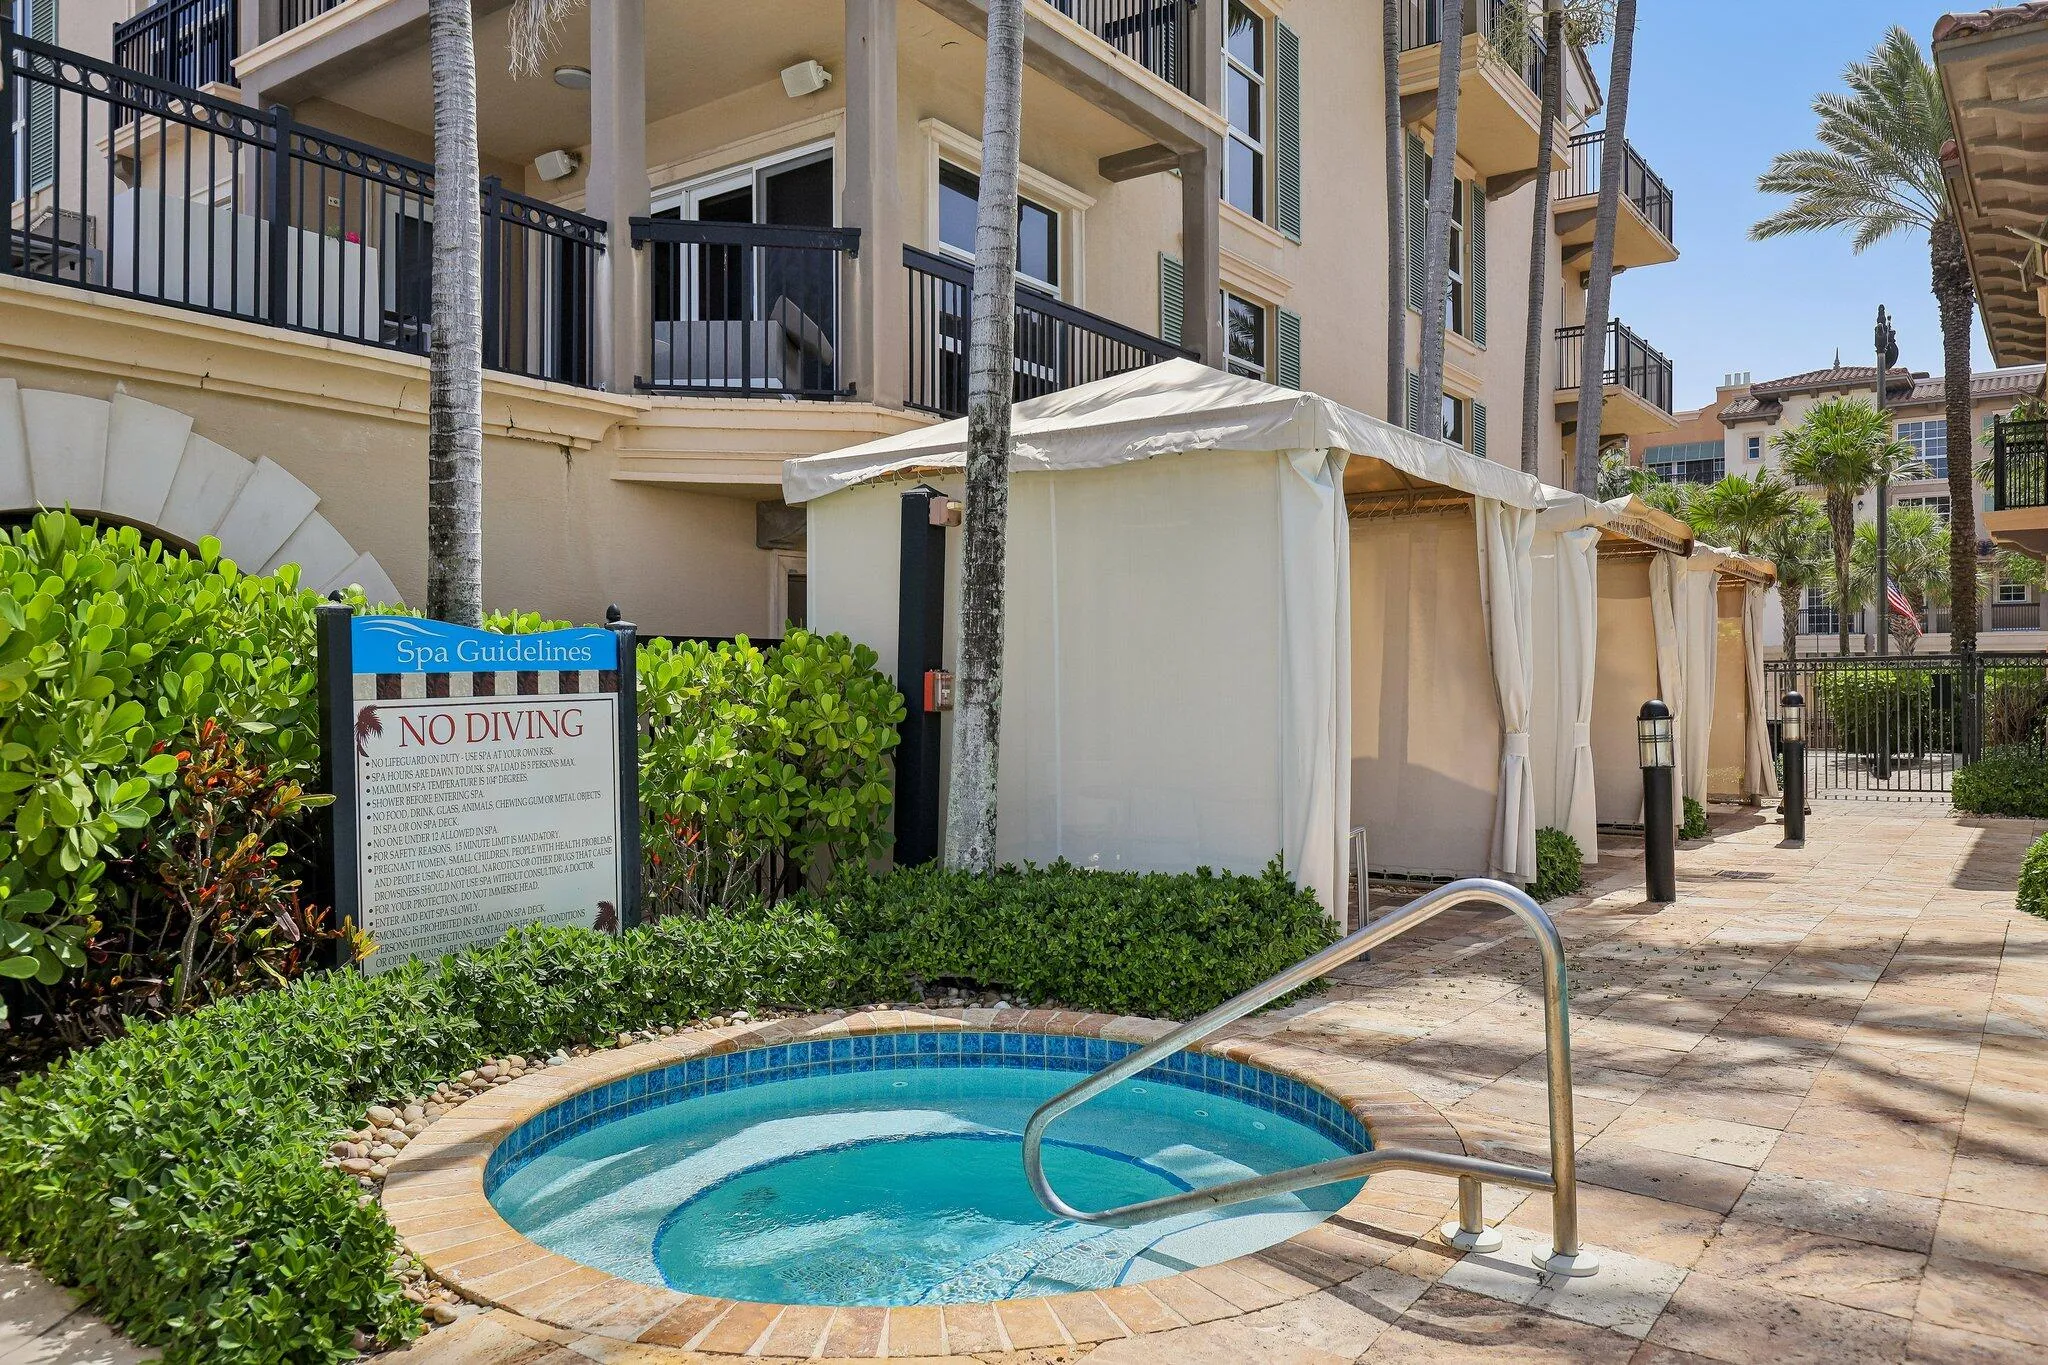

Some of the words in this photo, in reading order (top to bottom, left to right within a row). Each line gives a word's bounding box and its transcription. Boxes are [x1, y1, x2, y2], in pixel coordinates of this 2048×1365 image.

[398, 640, 449, 670] Spa
[457, 639, 591, 662] Guidelines
[398, 714, 456, 747] NO
[465, 709, 583, 743] DIVING
[371, 759, 384, 768] NO
[385, 756, 427, 767] LIFEGUARD
[428, 755, 439, 764] ON
[440, 754, 460, 763] DUTY
[465, 752, 478, 761] USE
[478, 752, 491, 760] SPA
[493, 751, 502, 759] AT
[503, 750, 521, 759] YOUR
[522, 748, 539, 757] OWN
[371, 772, 386, 782] SPA
[387, 770, 414, 781] HOURS
[415, 769, 430, 778] ARE
[430, 767, 454, 777] DAWN
[455, 767, 465, 776] TO
[486, 764, 500, 773] SPA
[500, 762, 520, 772] LOAD
[520, 762, 527, 770] IS
[527, 762, 531, 770] 5
[531, 760, 560, 770] PERSONS
[371, 784, 411, 795] MAXIMUM
[412, 782, 426, 792] SPA
[427, 778, 478, 790] TEMPERATURE
[478, 777, 485, 786] IS
[372, 797, 405, 808] SHOWER
[406, 794, 432, 805] BEFORE
[434, 791, 470, 803] ENTERING
[372, 812, 385, 822] NO
[496, 798, 528, 809] CHEWING
[528, 796, 545, 806] GUM
[544, 795, 554, 804] OR
[554, 793, 577, 803] METAL
[576, 790, 601, 801] OBJECTS
[373, 826, 381, 835] IN
[382, 824, 397, 834] SPA
[398, 823, 411, 832] OR
[411, 822, 422, 831] ON
[423, 820, 437, 830] SPA
[373, 839, 386, 848] NO
[386, 836, 404, 847] ONE
[404, 833, 431, 845] UNDER
[432, 832, 439, 841] 12
[440, 828, 475, 840] ALLOWED
[476, 827, 484, 836] IN
[373, 851, 389, 862] FOR
[390, 848, 417, 860] SAFETY
[455, 842, 463, 852] 15
[463, 839, 491, 850] MINUTE
[491, 836, 511, 847] LIMIT
[511, 836, 518, 844] IS
[373, 861, 416, 875] PREGNANT
[449, 854, 473, 865] SMALL
[512, 845, 536, 856] PEOPLE
[537, 843, 555, 853] WITH
[556, 839, 581, 850] HEALTH
[581, 835, 612, 847] PROBLEMS
[374, 878, 392, 888] AND
[393, 874, 421, 886] PEOPLE
[422, 870, 445, 882] USING
[482, 860, 520, 873] NARCOTICS
[520, 858, 531, 868] OR
[531, 855, 553, 866] OTHER
[554, 852, 575, 863] DRUGS
[575, 850, 592, 860] THAT
[592, 847, 612, 858] CAUSE
[374, 886, 421, 902] DROWSINESS
[420, 882, 450, 895] SHOULD
[450, 880, 465, 890] NOT
[466, 878, 479, 888] USE
[480, 876, 492, 886] SPA
[492, 871, 523, 884] WITHOUT
[523, 865, 564, 879] CONSULTING
[564, 864, 569, 873] A
[374, 904, 390, 915] FOR
[390, 901, 412, 912] YOUR
[460, 892, 471, 902] DO
[472, 889, 488, 900] NOT
[488, 884, 519, 897] IMMERSE
[375, 916, 400, 928] ENTER
[401, 913, 418, 924] AND
[420, 910, 435, 921] EXIT
[435, 908, 450, 918] SPA
[375, 927, 411, 942] SMOKING
[412, 926, 420, 935] IS
[420, 918, 462, 934] PROHIBITED
[463, 917, 471, 926] IN
[471, 914, 485, 925] SPA
[486, 912, 501, 922] AND
[502, 910, 514, 920] ON
[514, 907, 527, 917] SPA
[376, 941, 409, 955] ERSONS
[410, 937, 430, 948] WITH
[547, 909, 586, 924] CONDITIONS
[375, 958, 389, 968] OR
[412, 947, 443, 961] OUNDS
[444, 944, 458, 955] ARE
